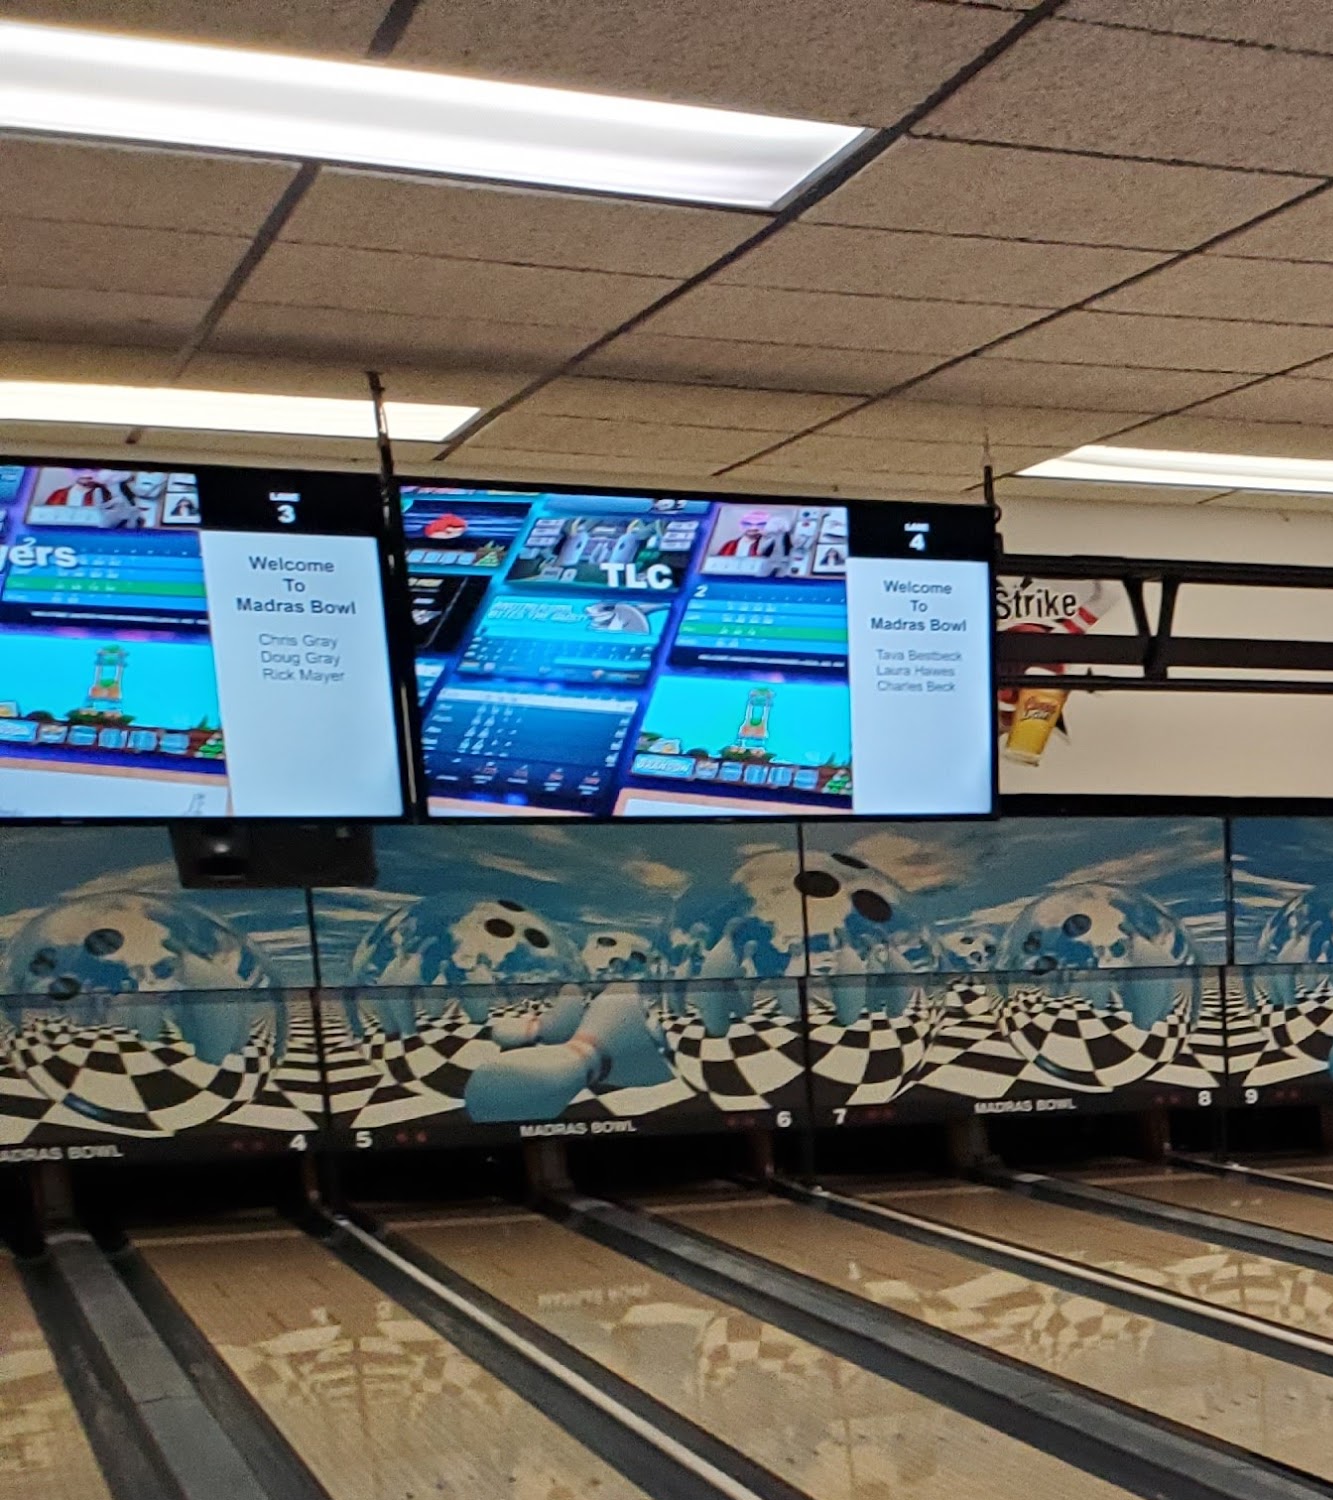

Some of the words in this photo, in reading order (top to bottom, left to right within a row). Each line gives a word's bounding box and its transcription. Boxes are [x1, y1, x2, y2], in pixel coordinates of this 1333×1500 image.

[277, 504, 296, 523] 3
[909, 533, 925, 550] 4
[249, 556, 335, 572] Welcome
[601, 563, 673, 589] TLC
[282, 578, 306, 592] To
[694, 585, 708, 598] 2
[884, 580, 952, 594] Welcome
[236, 598, 304, 613] Madras
[310, 600, 356, 614] Bowl
[910, 600, 928, 612] To
[996, 588, 1076, 619] Strike
[870, 618, 926, 631] Madras
[930, 619, 966, 632] Bowl
[259, 633, 298, 647] Chris
[302, 634, 338, 650] Gray
[261, 650, 300, 666] Doug
[305, 652, 340, 668] Gray
[263, 668, 296, 682] Rick
[1198, 1090, 1212, 1106] 8
[1244, 1088, 1258, 1104] 9
[974, 1100, 1032, 1114] MADRAS
[1036, 1098, 1077, 1111] BOWL
[776, 1111, 792, 1127] 6
[832, 1108, 848, 1126] 7
[520, 1122, 588, 1138] MADRAS
[591, 1120, 638, 1134] BOWL
[289, 1134, 308, 1152] 4
[356, 1130, 373, 1148] 5
[67, 1144, 125, 1160] BOWL
